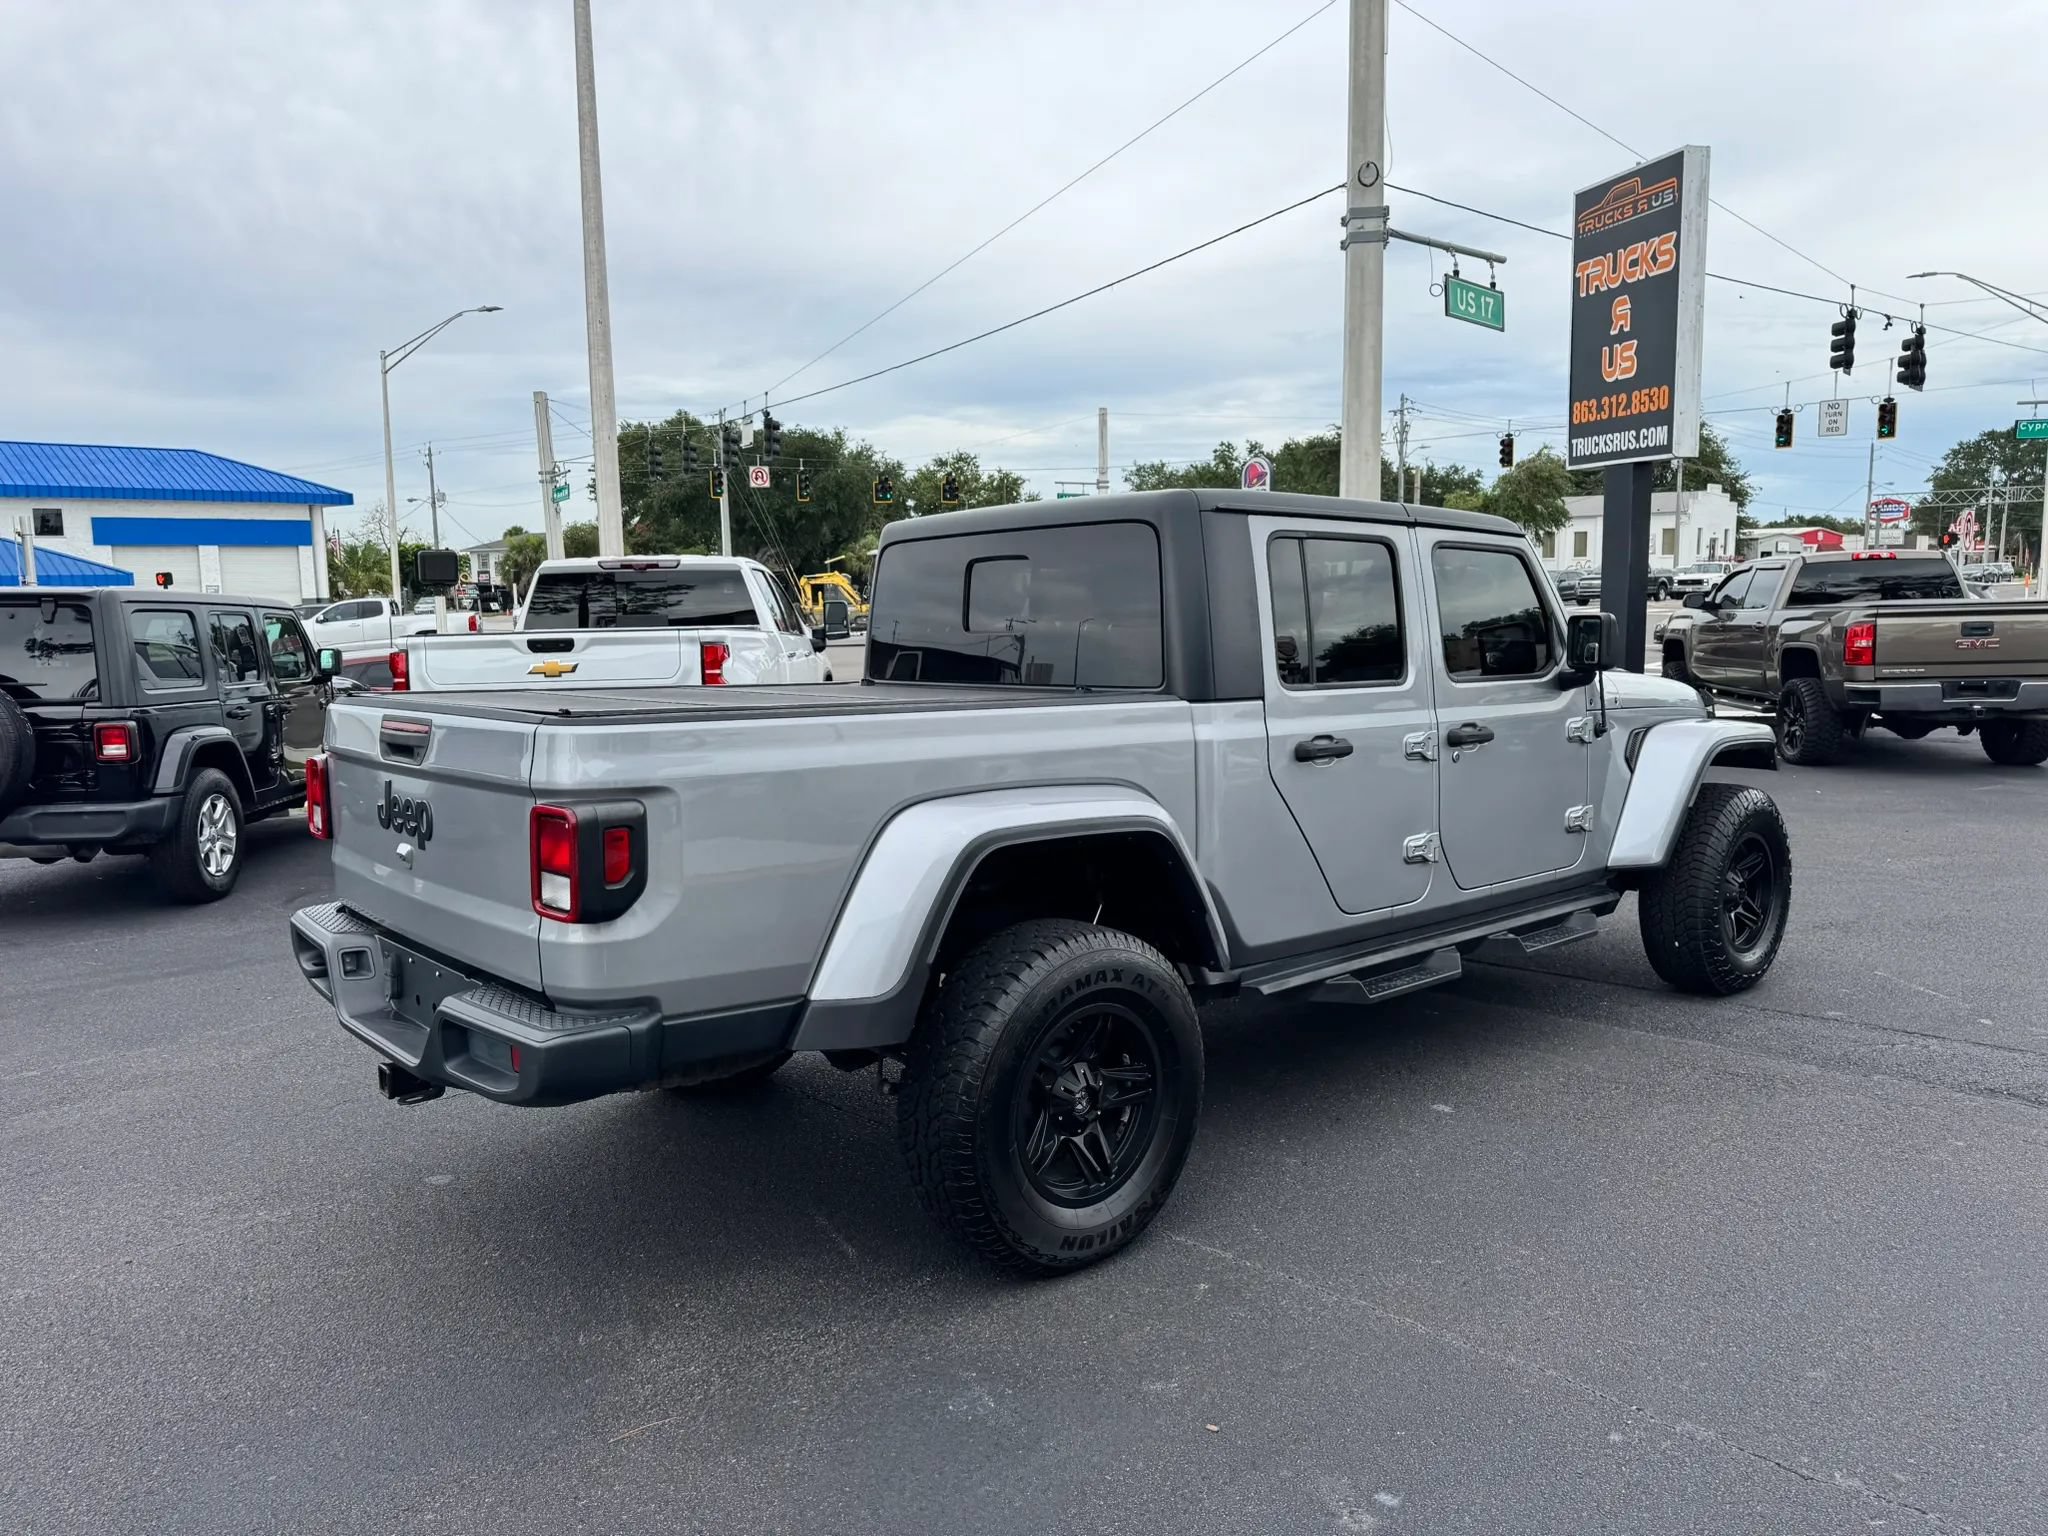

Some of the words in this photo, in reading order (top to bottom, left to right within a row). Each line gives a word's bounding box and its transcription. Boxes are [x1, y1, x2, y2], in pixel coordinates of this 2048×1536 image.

[1578, 204, 1633, 233] TRUCKS
[1652, 188, 1674, 206] US
[1575, 231, 1677, 297] TRUCKS
[1457, 288, 1475, 313] US
[1481, 295, 1494, 319] 17
[1602, 340, 1637, 382] US
[1573, 385, 1669, 424] 863.312.8530
[1827, 402, 1840, 410] NO
[1572, 425, 1668, 457] TRUCKSRUS.COM
[2020, 422, 2048, 431] Cypr
[1955, 638, 2000, 649] GMC
[377, 780, 433, 850] Jeep
